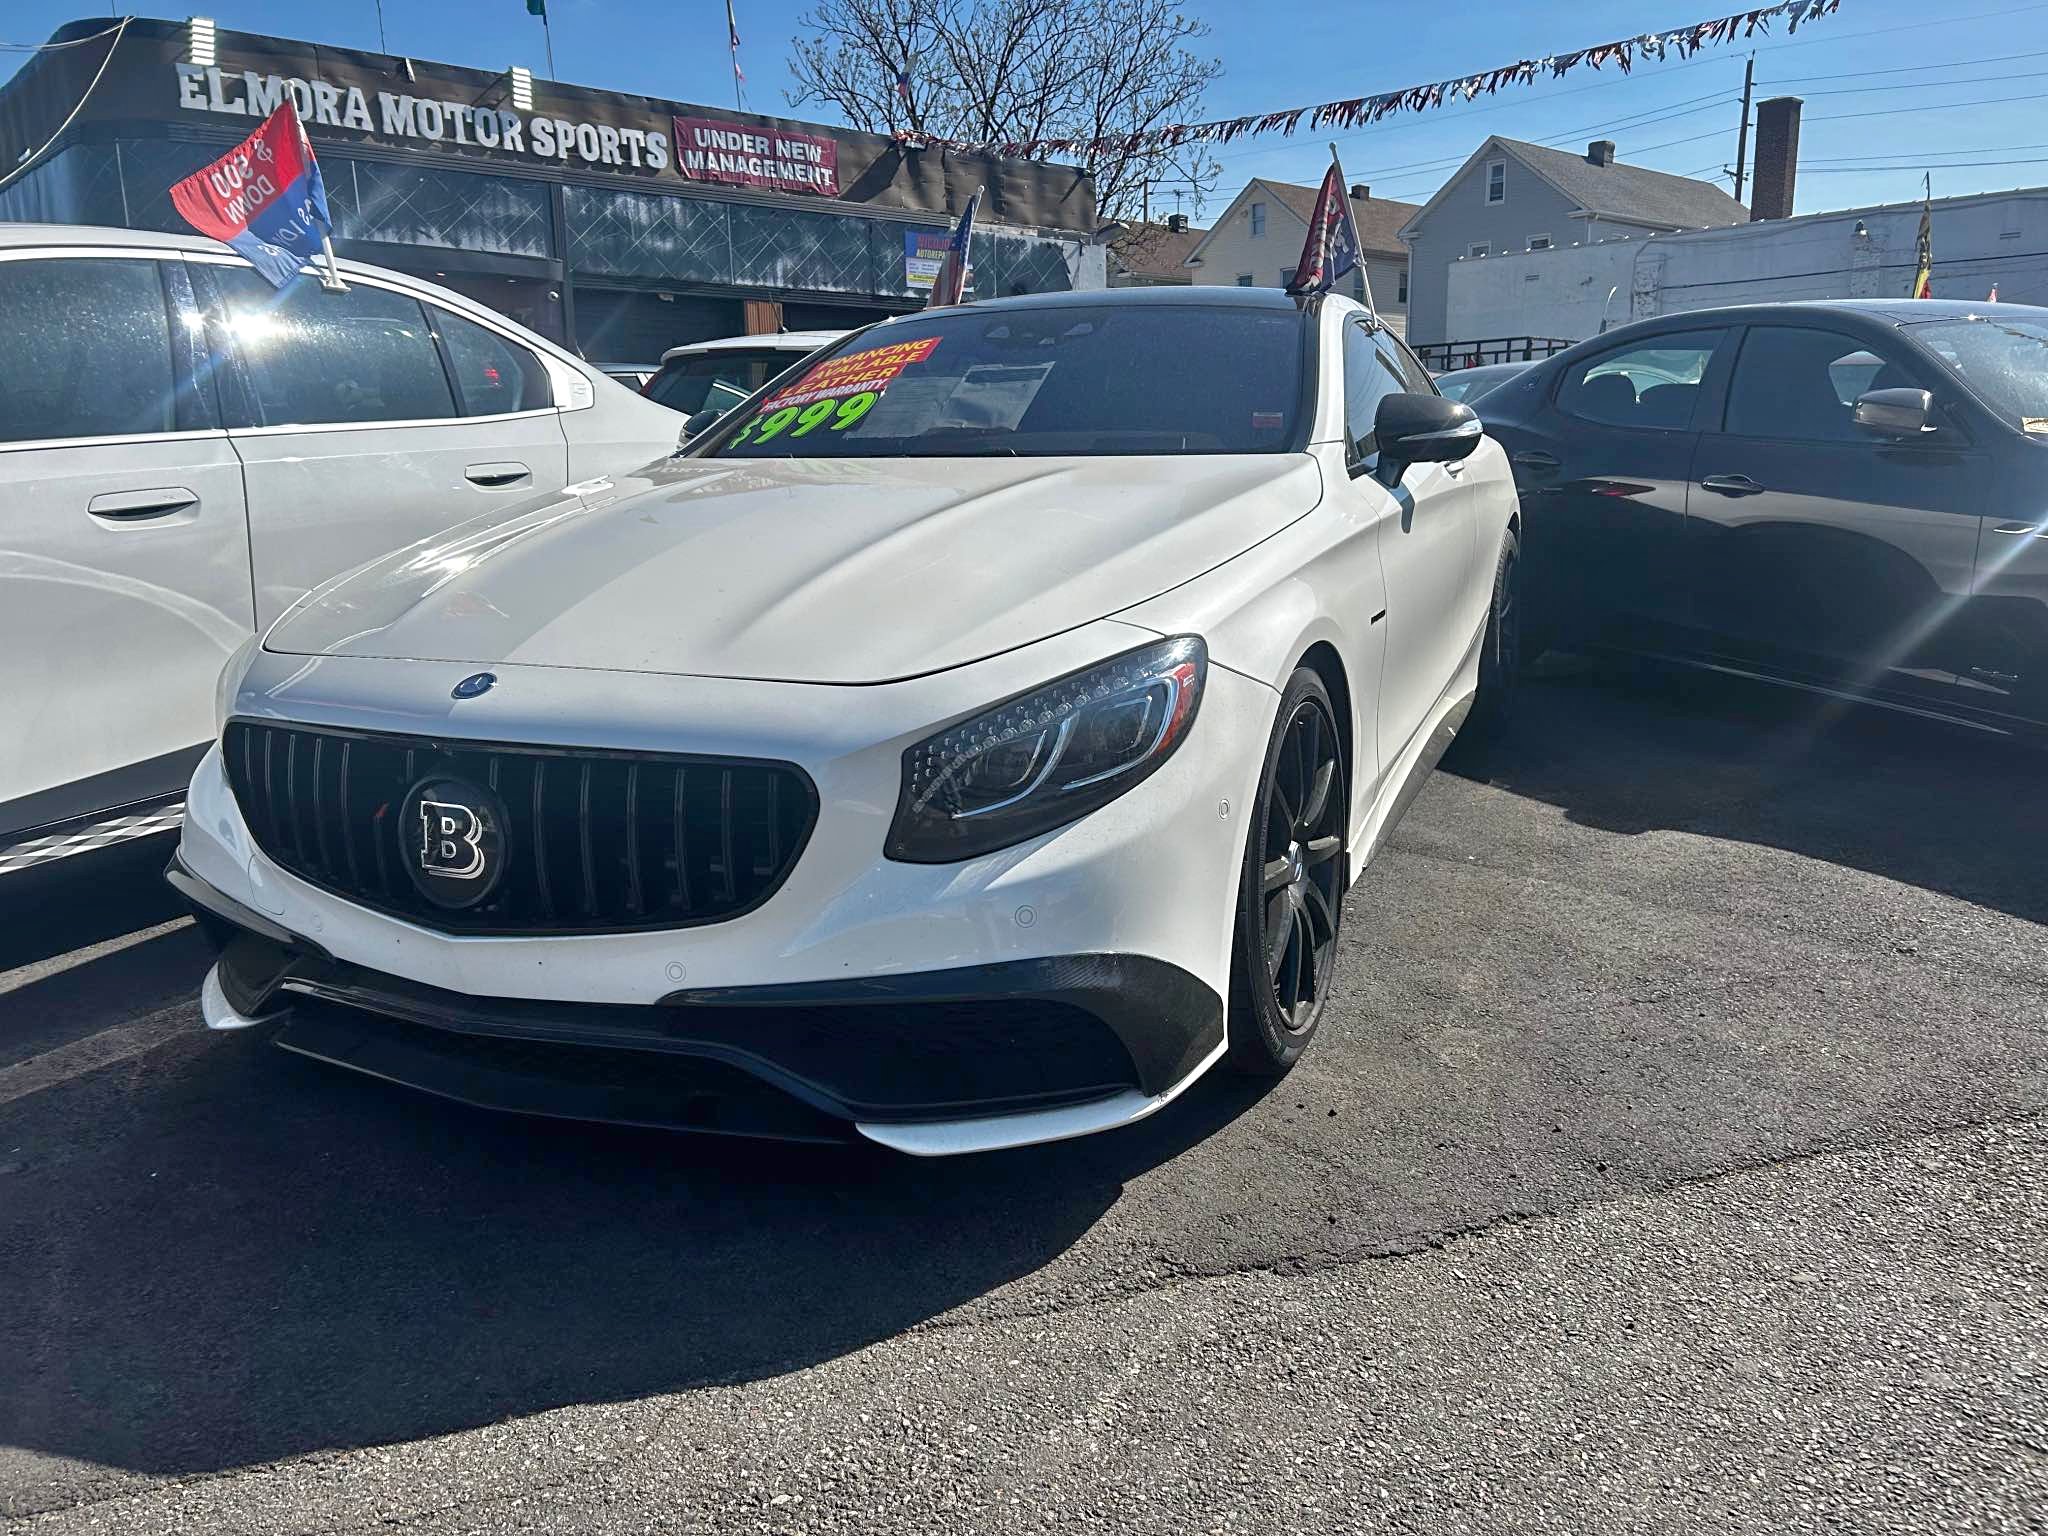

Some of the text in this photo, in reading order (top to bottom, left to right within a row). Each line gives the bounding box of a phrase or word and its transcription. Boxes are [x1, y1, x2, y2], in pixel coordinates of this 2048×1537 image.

[176, 63, 668, 170] ELMORA MOTOR SPORTS
[694, 127, 822, 163] UNDER NEW
[684, 150, 833, 186] MANAGEMENT
[808, 350, 922, 381] AVAILABLE
[818, 338, 933, 370] FINANCING
[759, 378, 888, 413] FACTORY WARRANTY
[781, 366, 898, 399] LEATHER
[728, 391, 879, 450] $999
[420, 800, 485, 879] B
